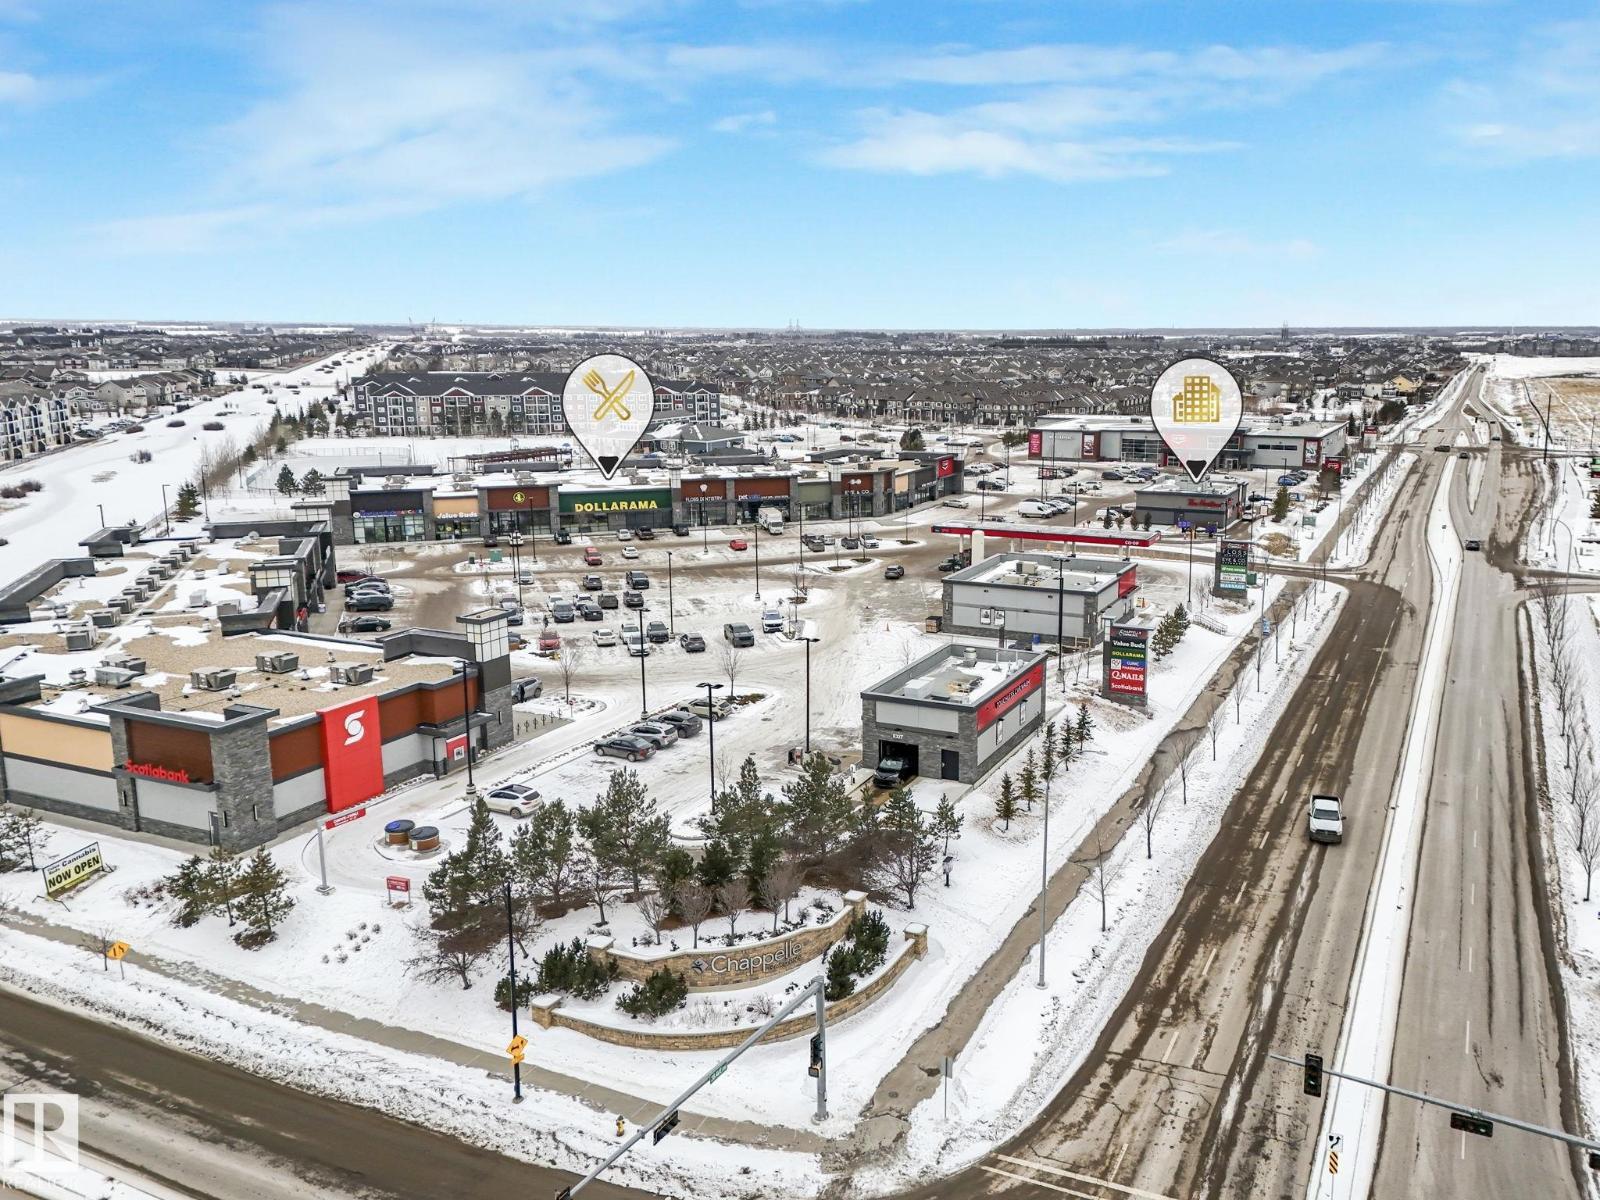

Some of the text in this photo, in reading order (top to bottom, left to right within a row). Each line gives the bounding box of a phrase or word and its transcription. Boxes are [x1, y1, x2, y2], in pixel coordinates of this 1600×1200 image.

[574, 500, 658, 512] DOLLARAMA
[1130, 641, 1145, 649] Buds
[1112, 651, 1144, 659] DOLLARAMA
[1111, 683, 1143, 692] Scotiabank
[126, 759, 190, 784] Scotiabank
[61, 847, 97, 868] Cannabis
[48, 855, 100, 888] NOW OPEN
[711, 941, 802, 975] Chappelle
